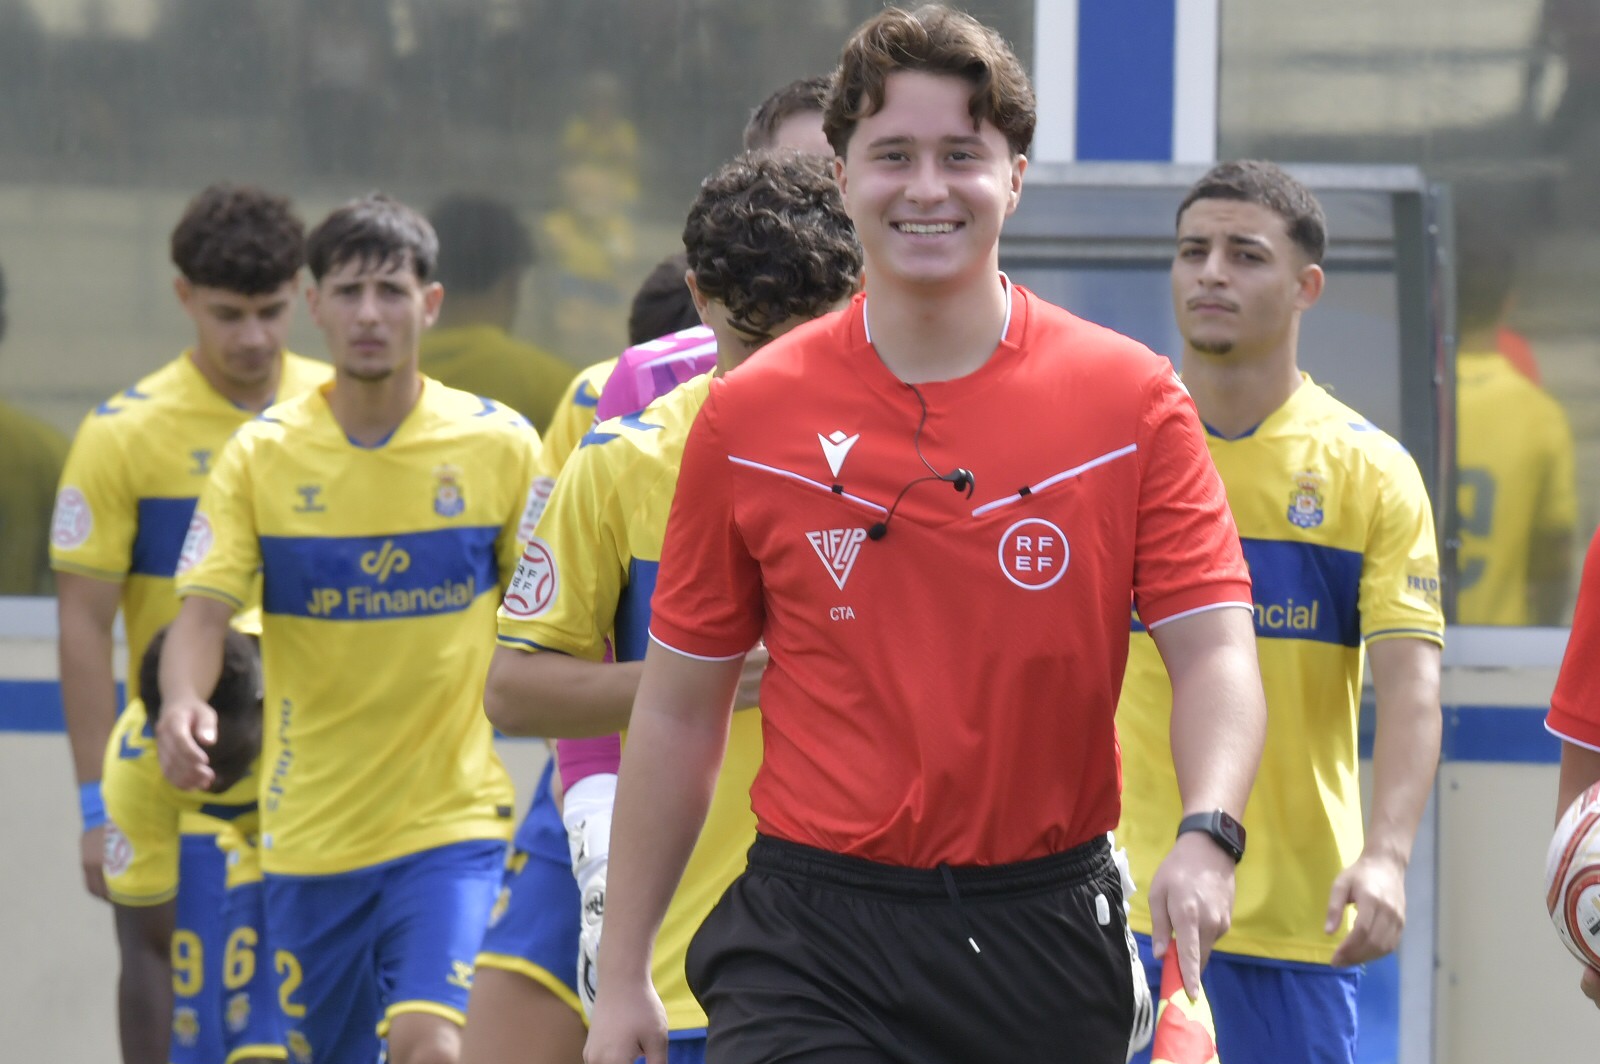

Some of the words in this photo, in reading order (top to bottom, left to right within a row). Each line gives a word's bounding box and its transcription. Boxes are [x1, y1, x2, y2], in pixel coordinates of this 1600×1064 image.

[306, 587, 342, 615] JP
[346, 576, 475, 615] Financial
[829, 606, 856, 621] CTA
[170, 929, 204, 997] 9
[223, 926, 258, 990] 6
[274, 949, 307, 1018] 2
